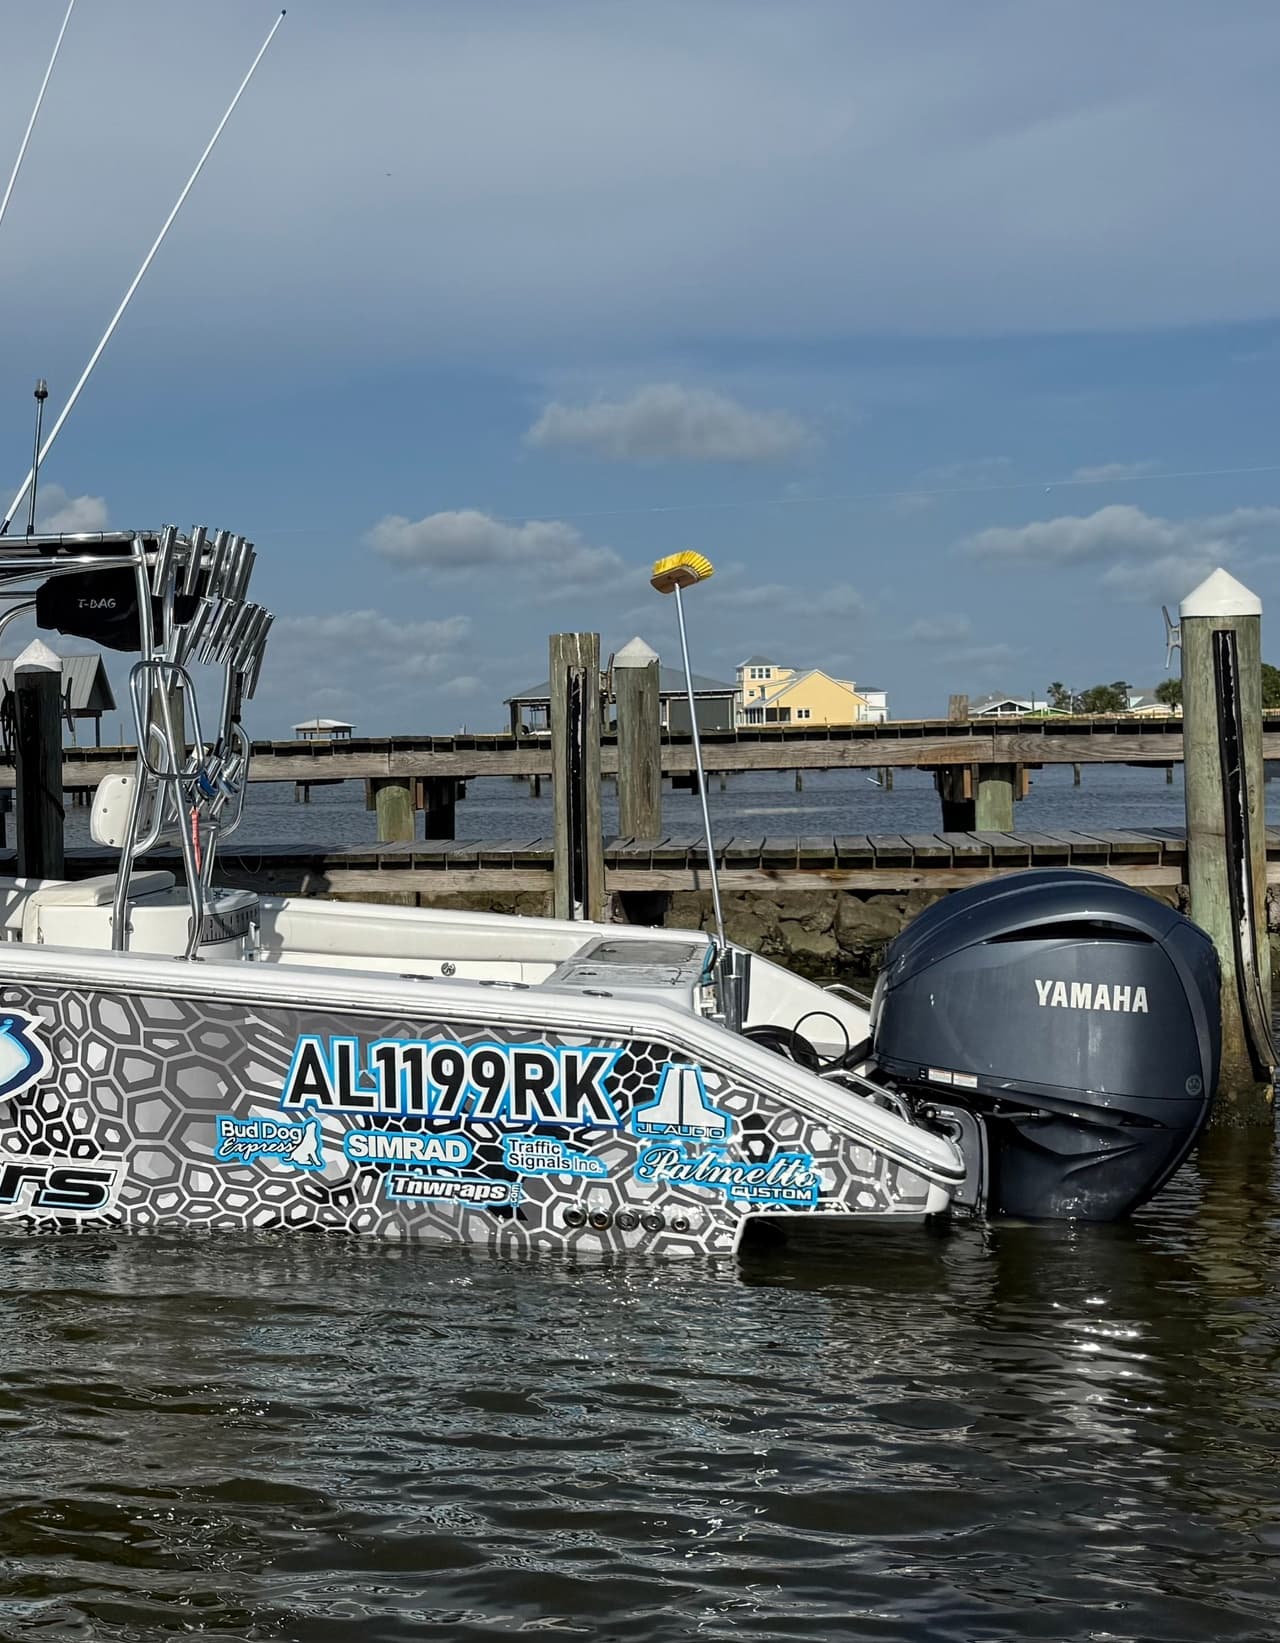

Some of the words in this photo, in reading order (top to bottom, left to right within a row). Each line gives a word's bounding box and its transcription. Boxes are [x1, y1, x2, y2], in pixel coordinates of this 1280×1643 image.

[1034, 979, 1149, 1013] YAMAHA
[288, 1042, 610, 1120] AL1199RK
[221, 1120, 259, 1138] Bud
[262, 1122, 303, 1144] Dog
[637, 1123, 662, 1134] JL
[664, 1124, 725, 1139] AUDIO
[219, 1136, 297, 1160] Express
[348, 1134, 468, 1163] SIMRAD
[508, 1138, 561, 1155] Traffic
[508, 1152, 571, 1171] Signals
[573, 1157, 604, 1173] Inc.
[639, 1149, 818, 1188] Palmetto
[394, 1176, 506, 1201] Tnwraps
[730, 1185, 812, 1200] CUSTOM
